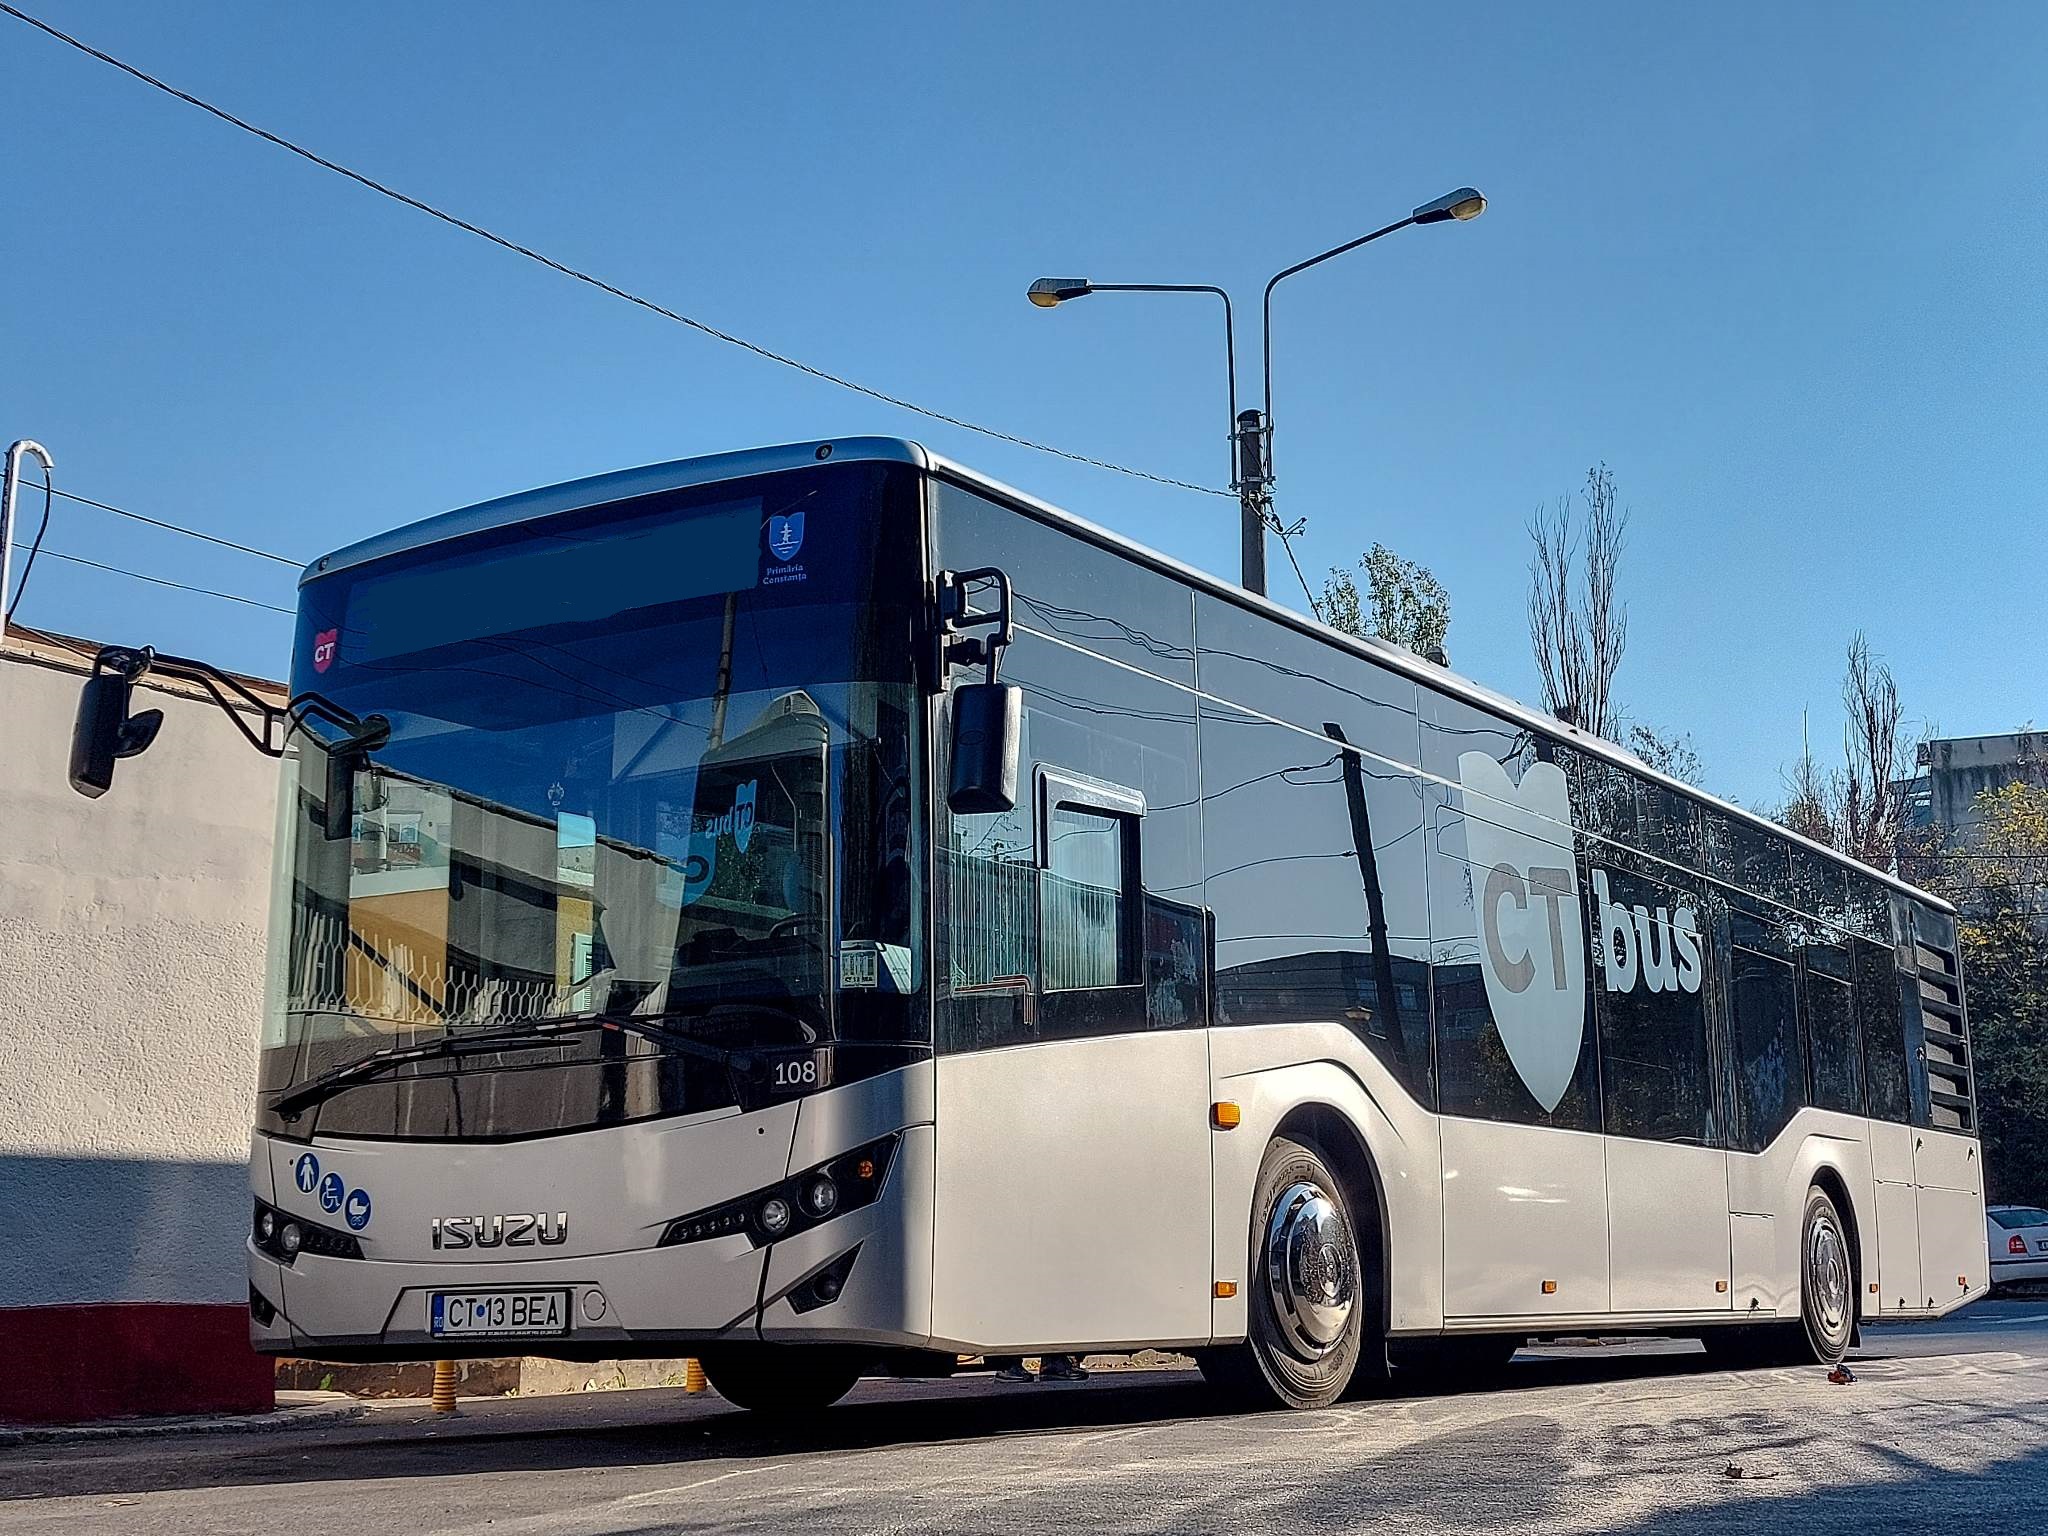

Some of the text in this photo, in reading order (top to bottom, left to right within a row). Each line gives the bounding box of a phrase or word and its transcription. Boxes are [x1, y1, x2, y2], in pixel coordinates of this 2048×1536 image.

[314, 642, 335, 663] CT
[1483, 862, 1702, 993] CT bus
[775, 1060, 816, 1085] 108
[431, 1211, 568, 1250] ISUZU
[449, 1297, 477, 1328] CT
[485, 1296, 506, 1327] 13
[511, 1295, 559, 1326] BEA
